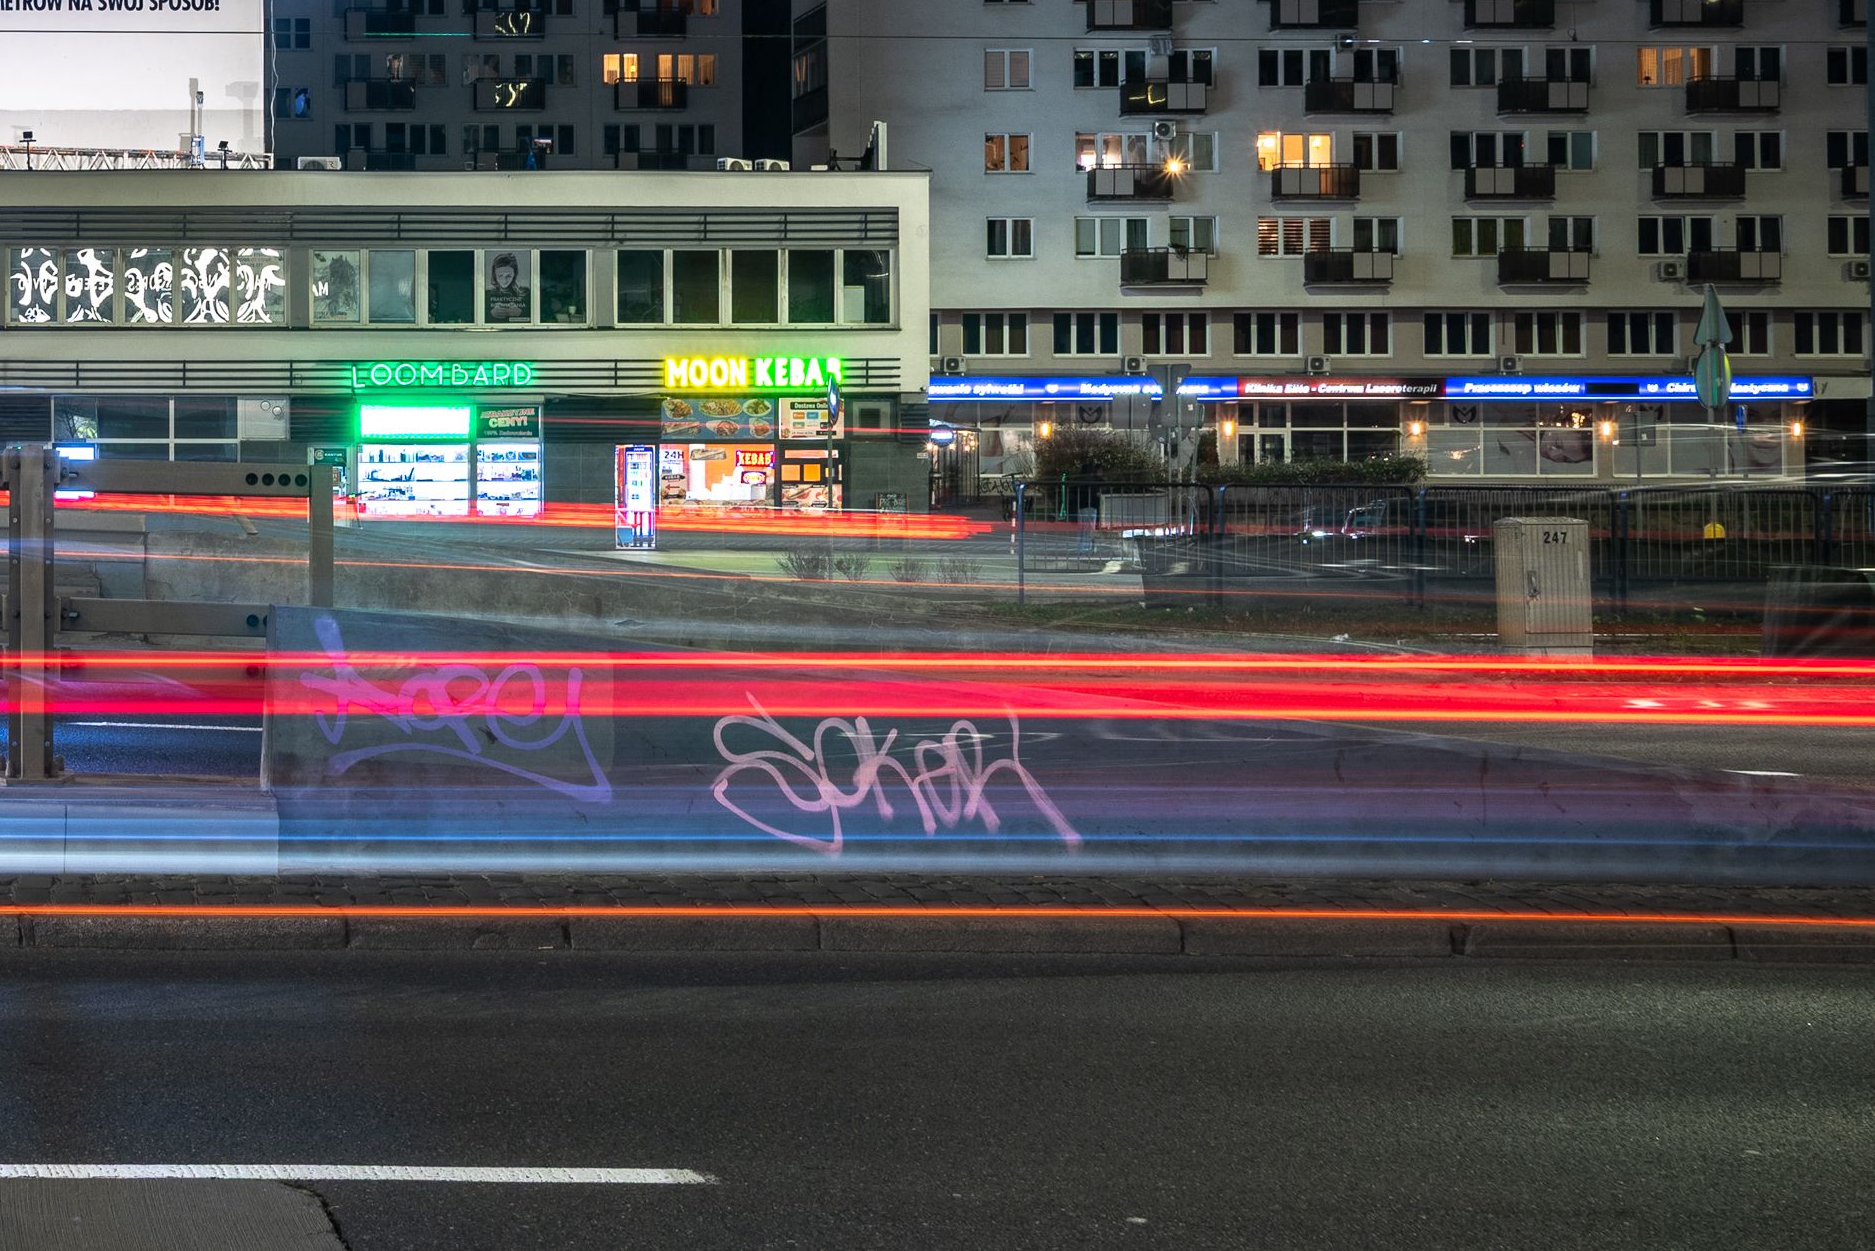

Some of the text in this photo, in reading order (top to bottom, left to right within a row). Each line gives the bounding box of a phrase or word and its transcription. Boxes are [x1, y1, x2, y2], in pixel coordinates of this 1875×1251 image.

[352, 363, 532, 388] LOOMBARD
[666, 357, 842, 387] MOON KEBAB
[1245, 383, 1283, 393] Klinika
[1318, 383, 1364, 393] Centrum
[489, 416, 528, 428] CENY!
[664, 450, 684, 459] 24H
[739, 452, 772, 465] KEBAB
[1543, 531, 1567, 544] 247
